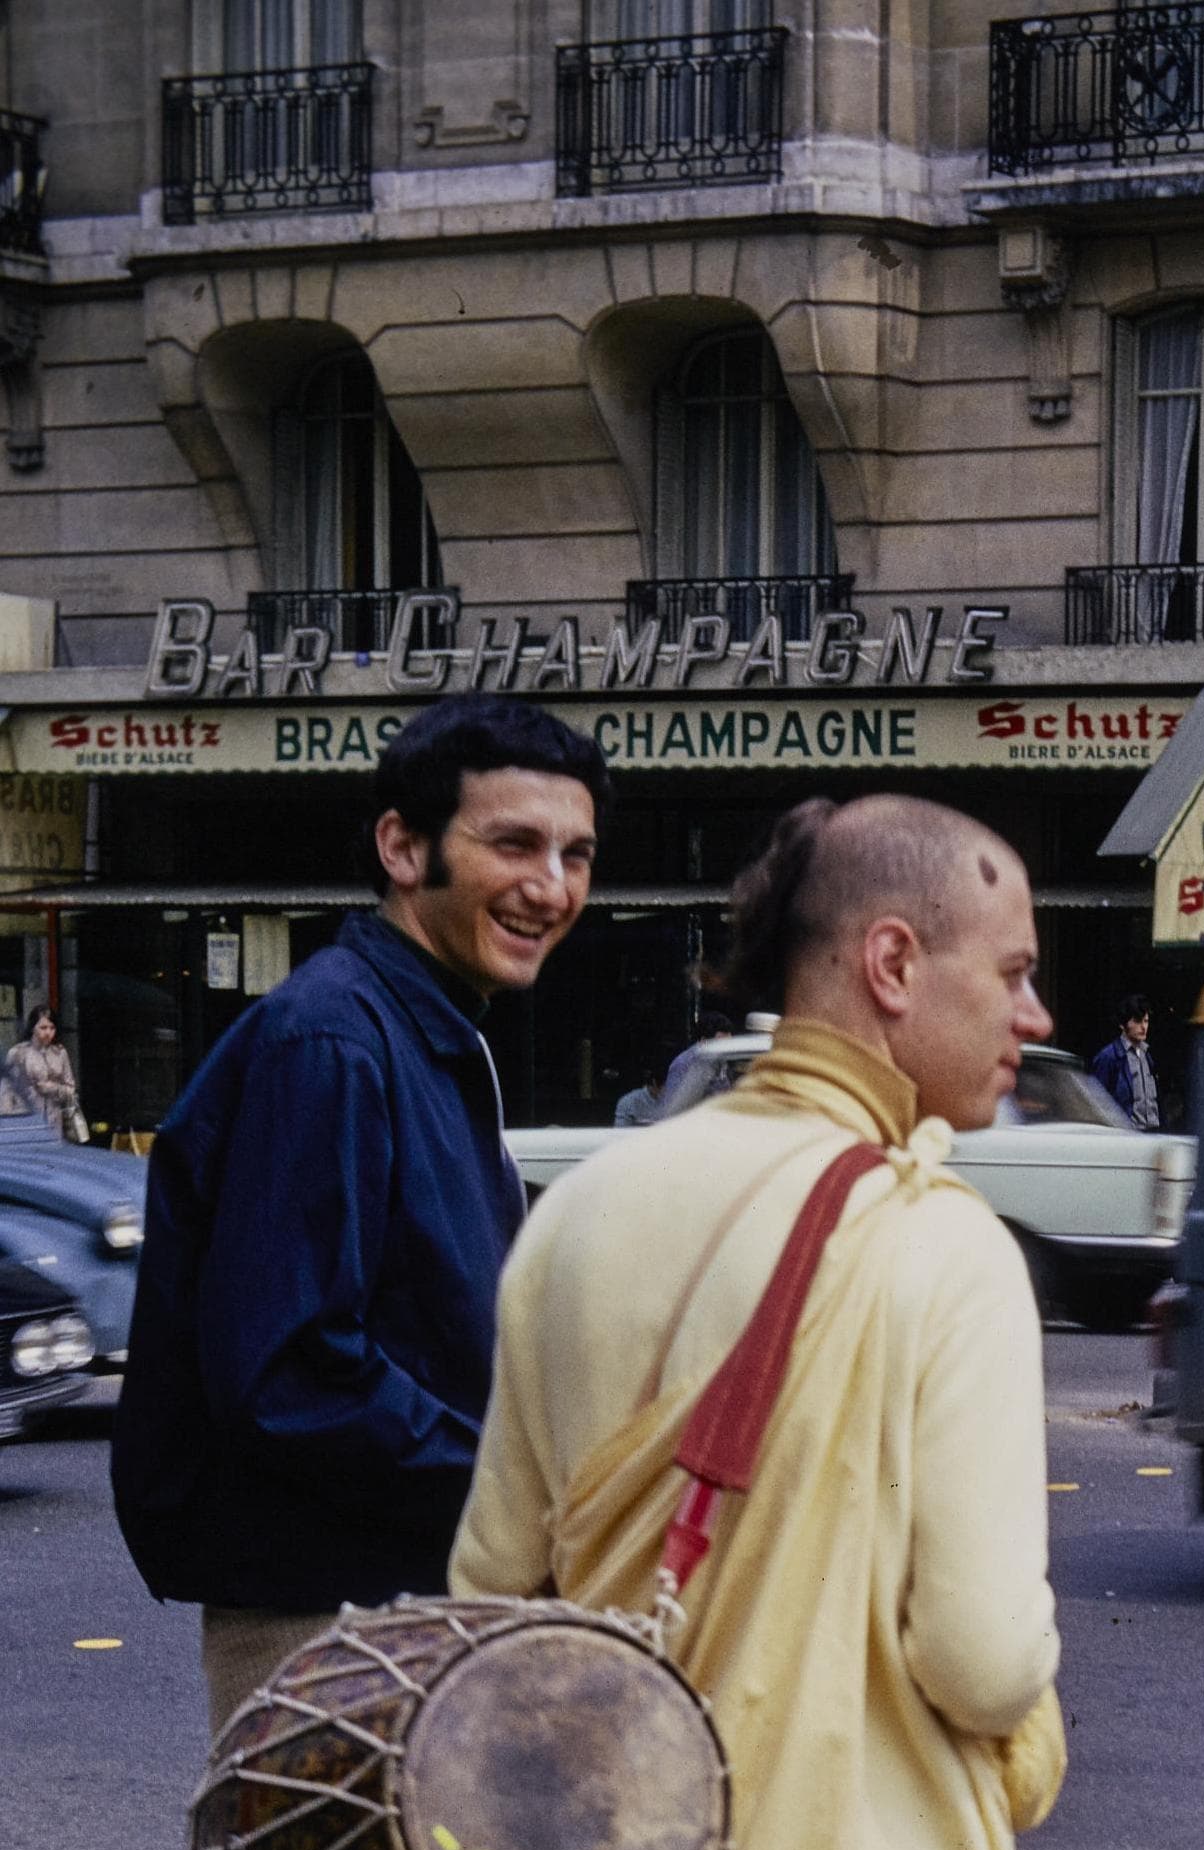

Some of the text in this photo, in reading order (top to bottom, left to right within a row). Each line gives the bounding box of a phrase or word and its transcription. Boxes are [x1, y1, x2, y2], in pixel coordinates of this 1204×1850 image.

[50, 713, 222, 748] Schutz
[275, 708, 916, 763] BRAS CHAMPAGNE
[977, 701, 1185, 740] Schutz
[1067, 745, 1150, 759] D'ALSACE
